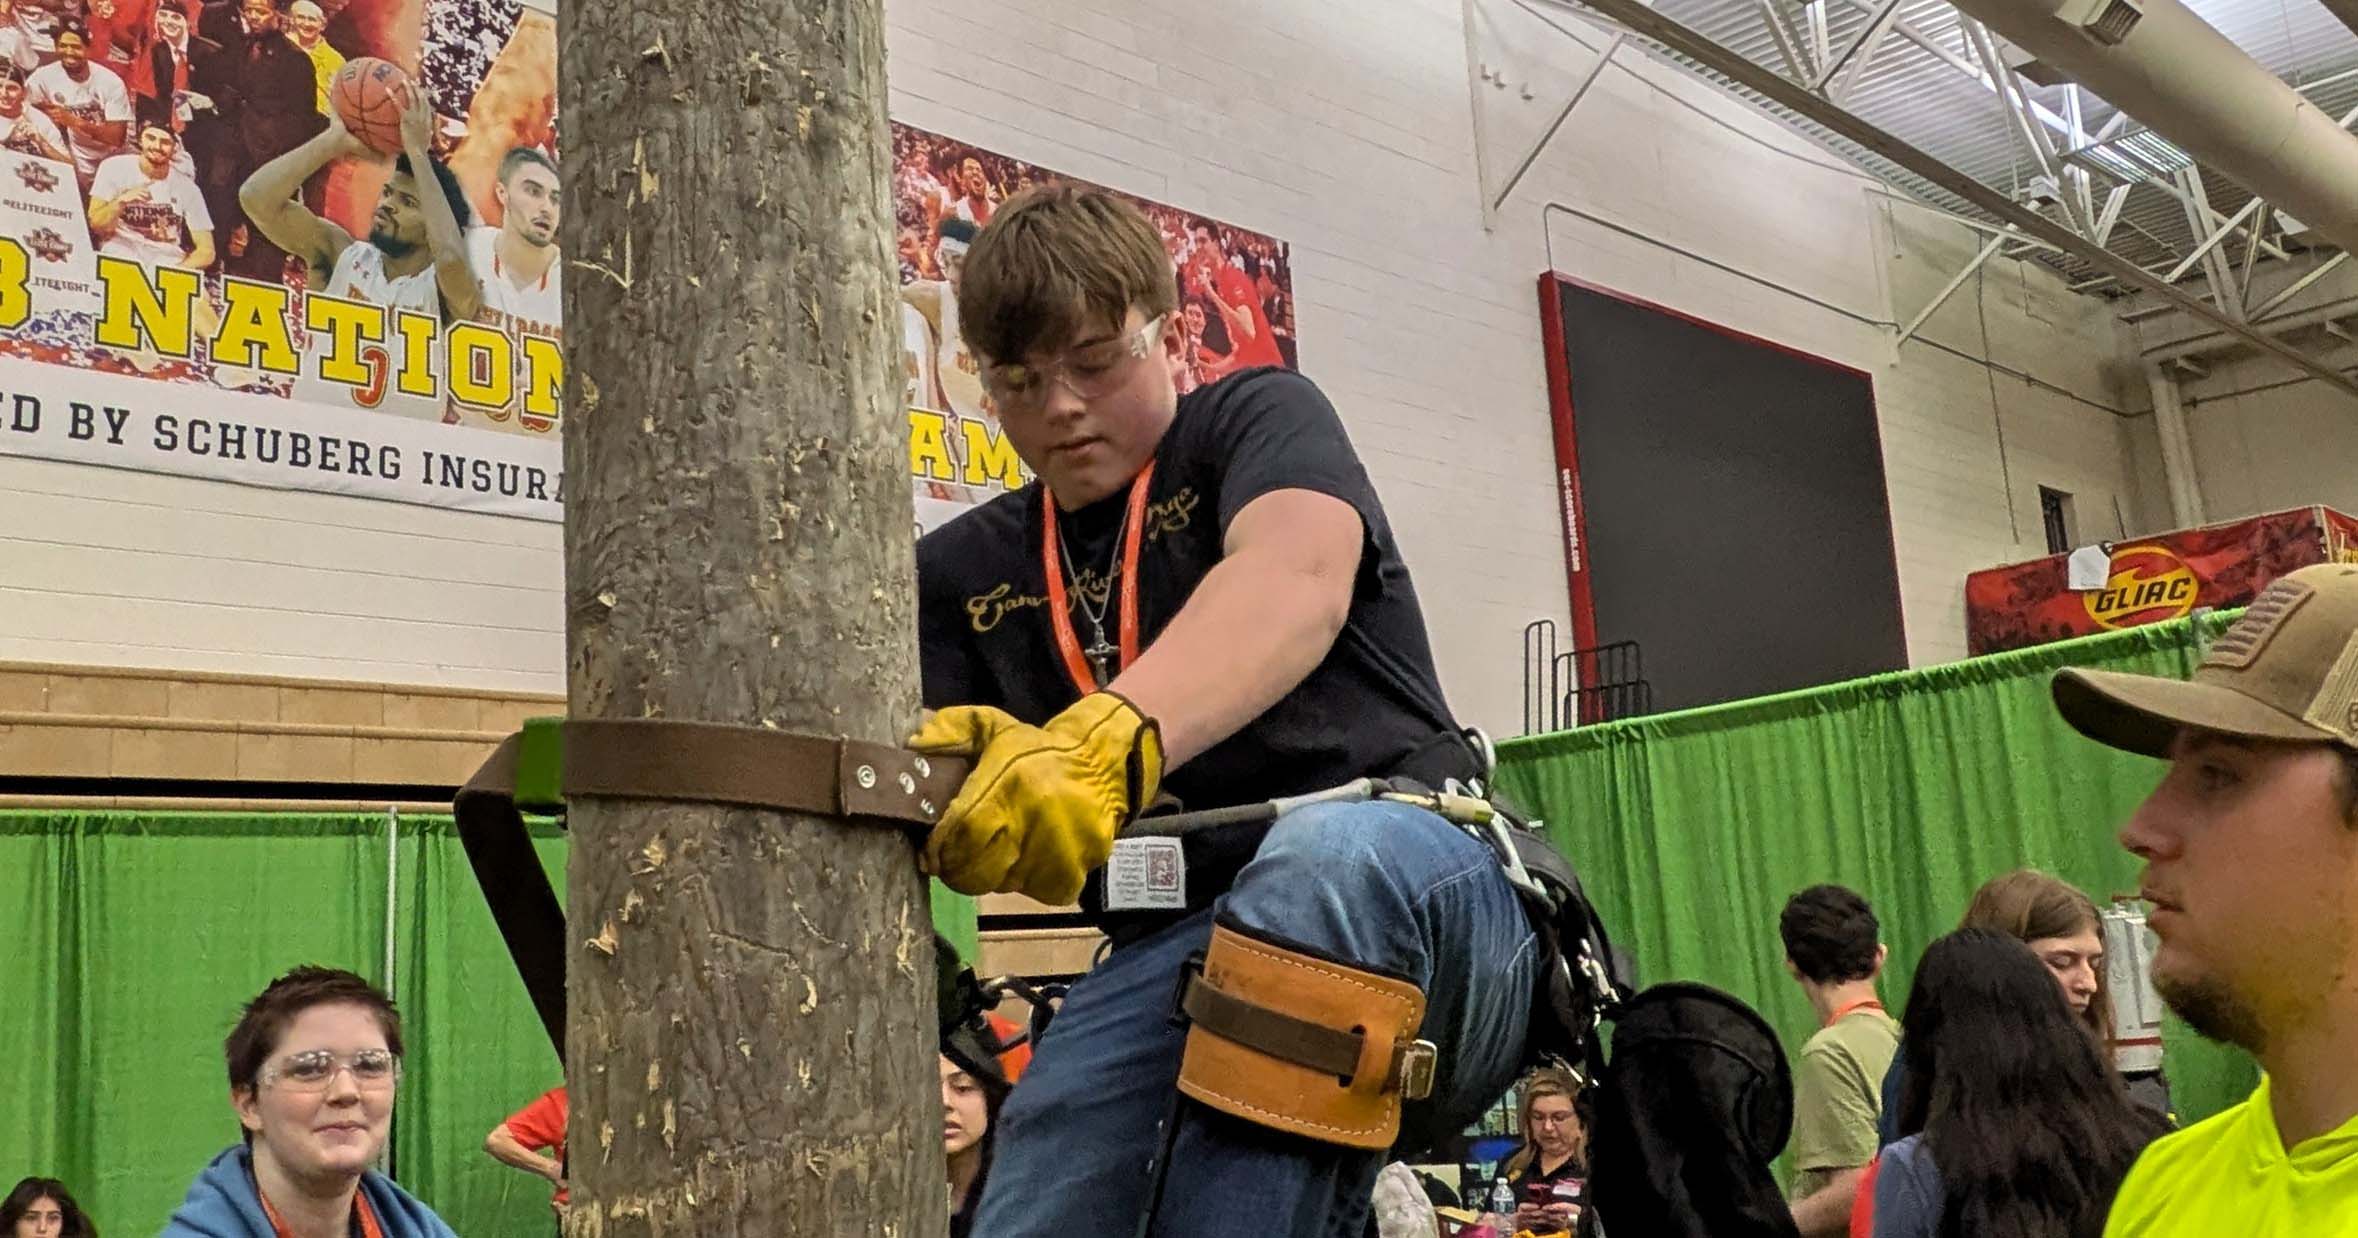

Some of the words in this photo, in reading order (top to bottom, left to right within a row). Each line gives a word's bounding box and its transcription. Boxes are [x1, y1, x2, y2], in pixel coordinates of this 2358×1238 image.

[0, 391, 41, 433] D
[68, 402, 130, 445] BY
[154, 414, 402, 480] SCHUBERG
[2095, 577, 2191, 613] GLIAC
